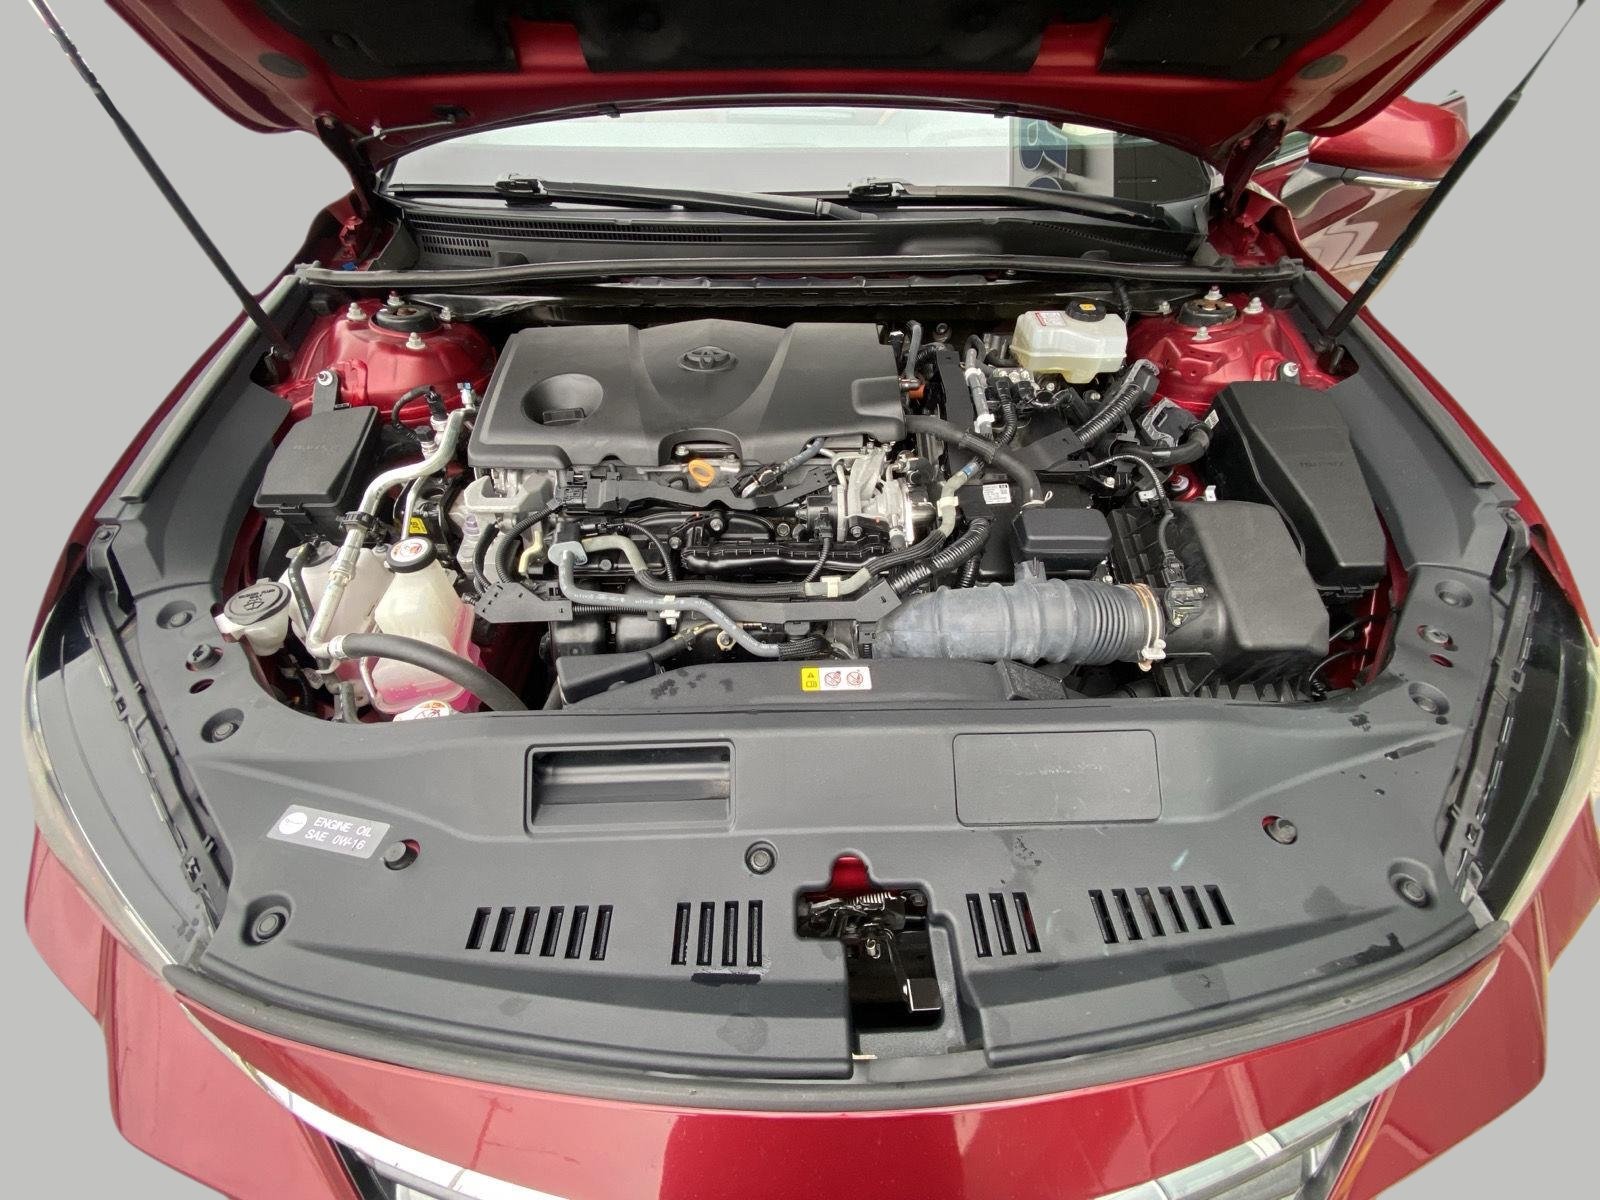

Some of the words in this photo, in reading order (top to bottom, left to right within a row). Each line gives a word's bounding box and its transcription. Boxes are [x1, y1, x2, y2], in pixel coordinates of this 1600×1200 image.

[313, 816, 353, 833] ENGINE
[356, 824, 372, 838] OIL
[304, 829, 329, 842] SAE
[332, 834, 366, 850] 0W-16
